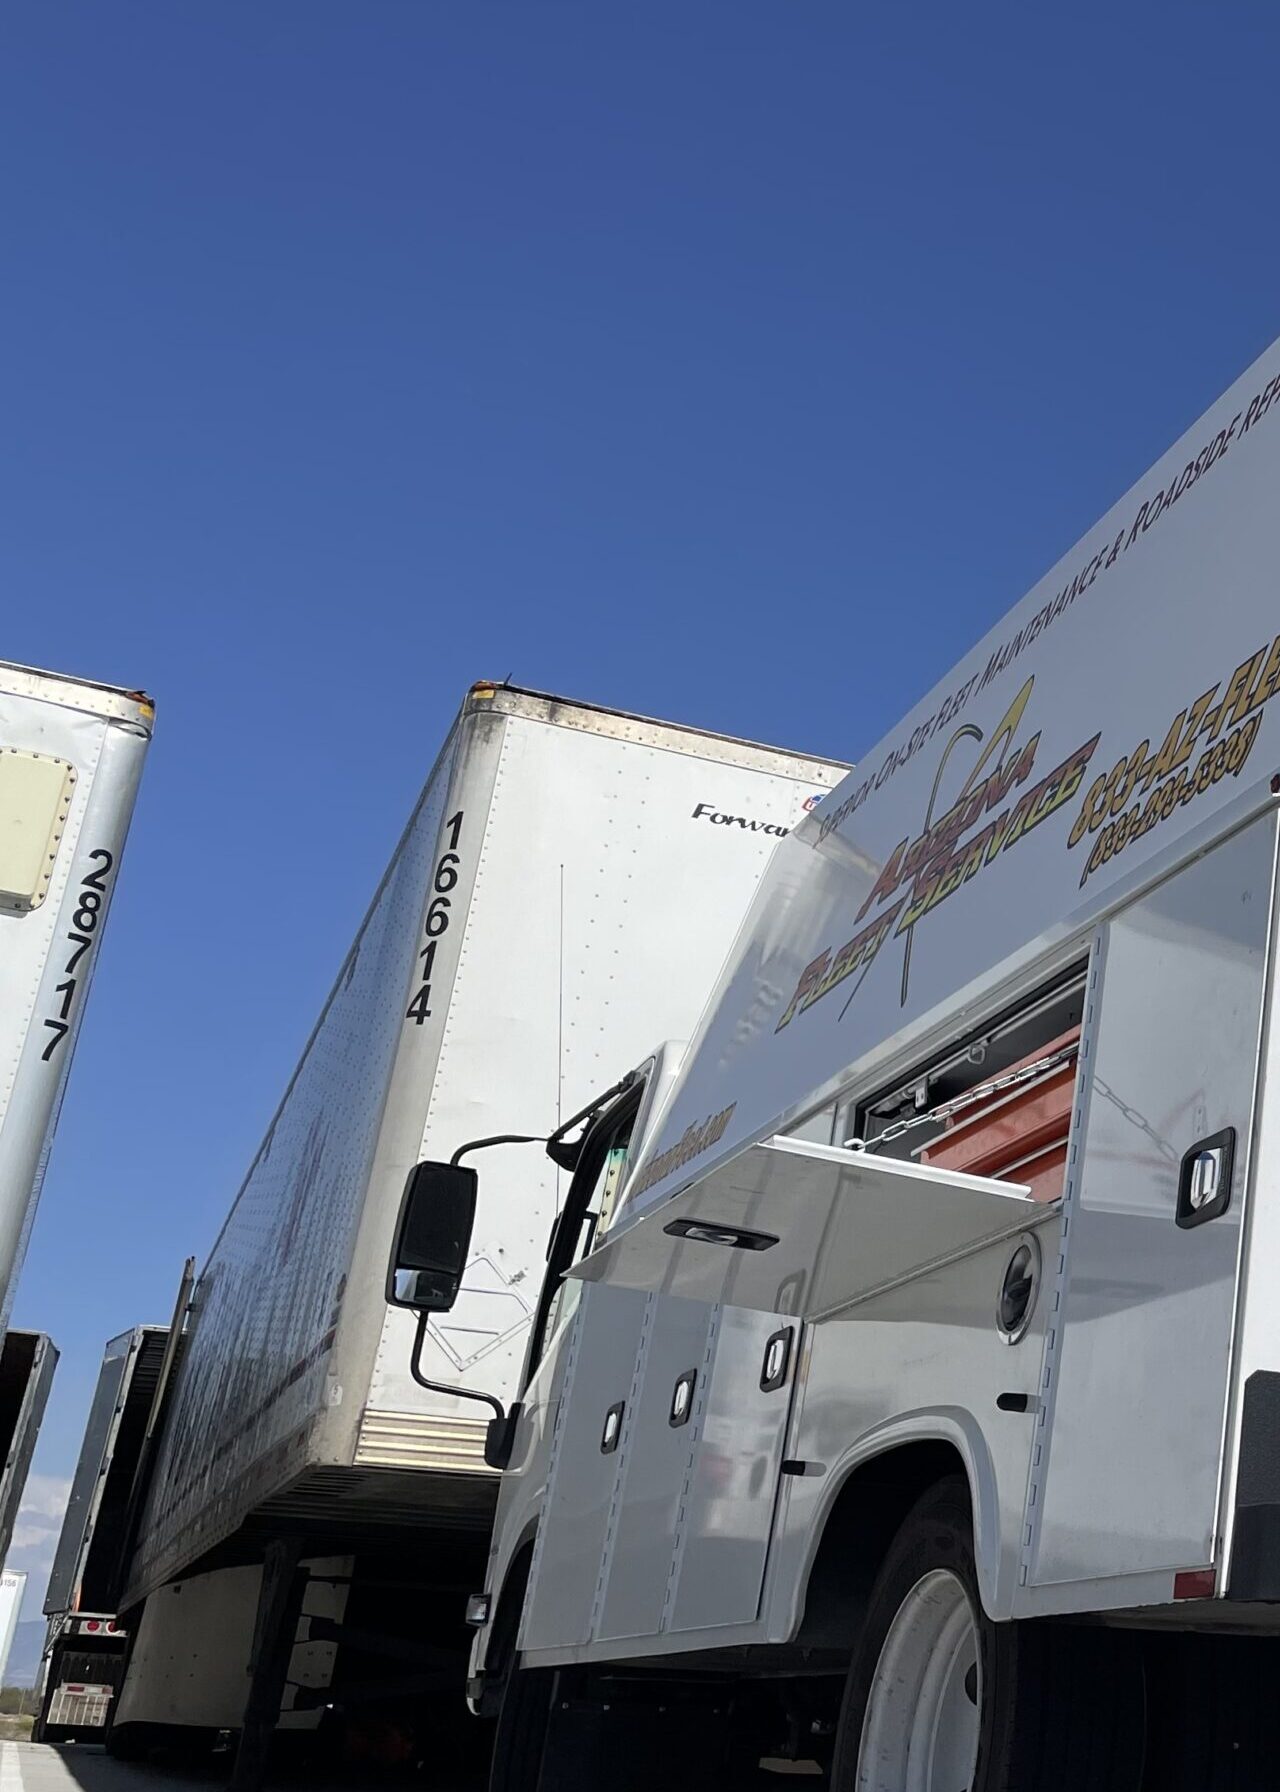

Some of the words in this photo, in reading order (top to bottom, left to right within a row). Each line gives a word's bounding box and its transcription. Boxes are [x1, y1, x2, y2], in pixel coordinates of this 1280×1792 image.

[874, 714, 937, 790] ON-SITE
[929, 672, 979, 740] FLEET
[974, 545, 1109, 697] MAINTENANCE
[1105, 528, 1125, 570] &
[1124, 412, 1242, 552] ROADSIDE
[1079, 708, 1264, 890] (833-293-5338)
[41, 848, 113, 1062] 28717
[406, 811, 464, 1025] 16614
